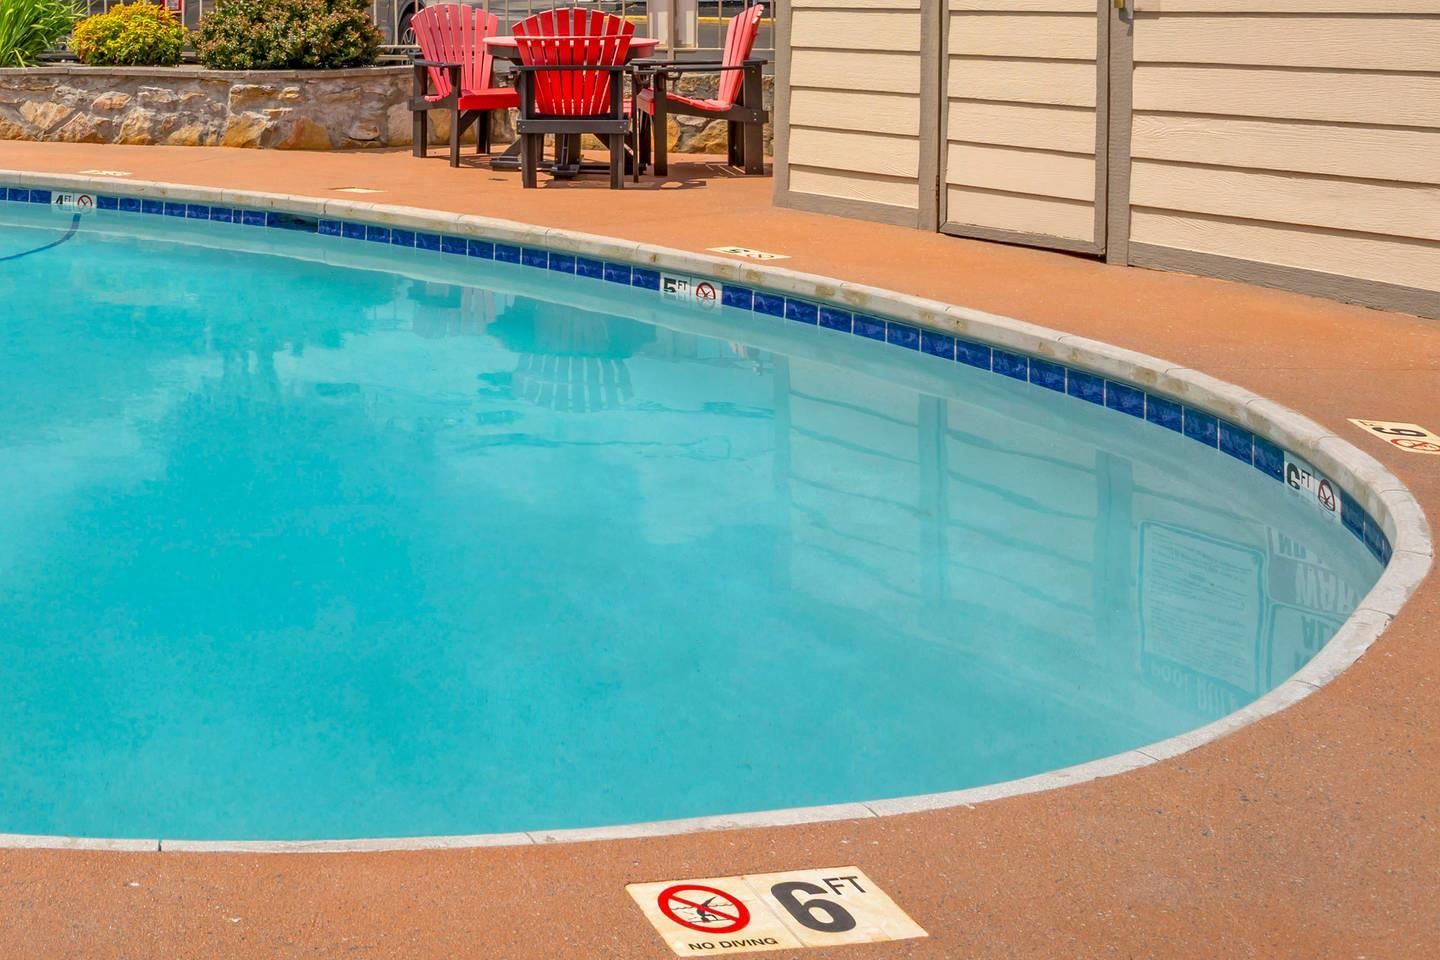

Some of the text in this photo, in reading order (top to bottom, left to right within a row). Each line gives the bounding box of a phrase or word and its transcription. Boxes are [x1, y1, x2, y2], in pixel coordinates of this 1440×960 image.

[663, 277, 688, 293] 5 FT
[1300, 470, 1312, 489] FT
[770, 875, 868, 933] 6 FT
[688, 937, 780, 951] NO DIVING
